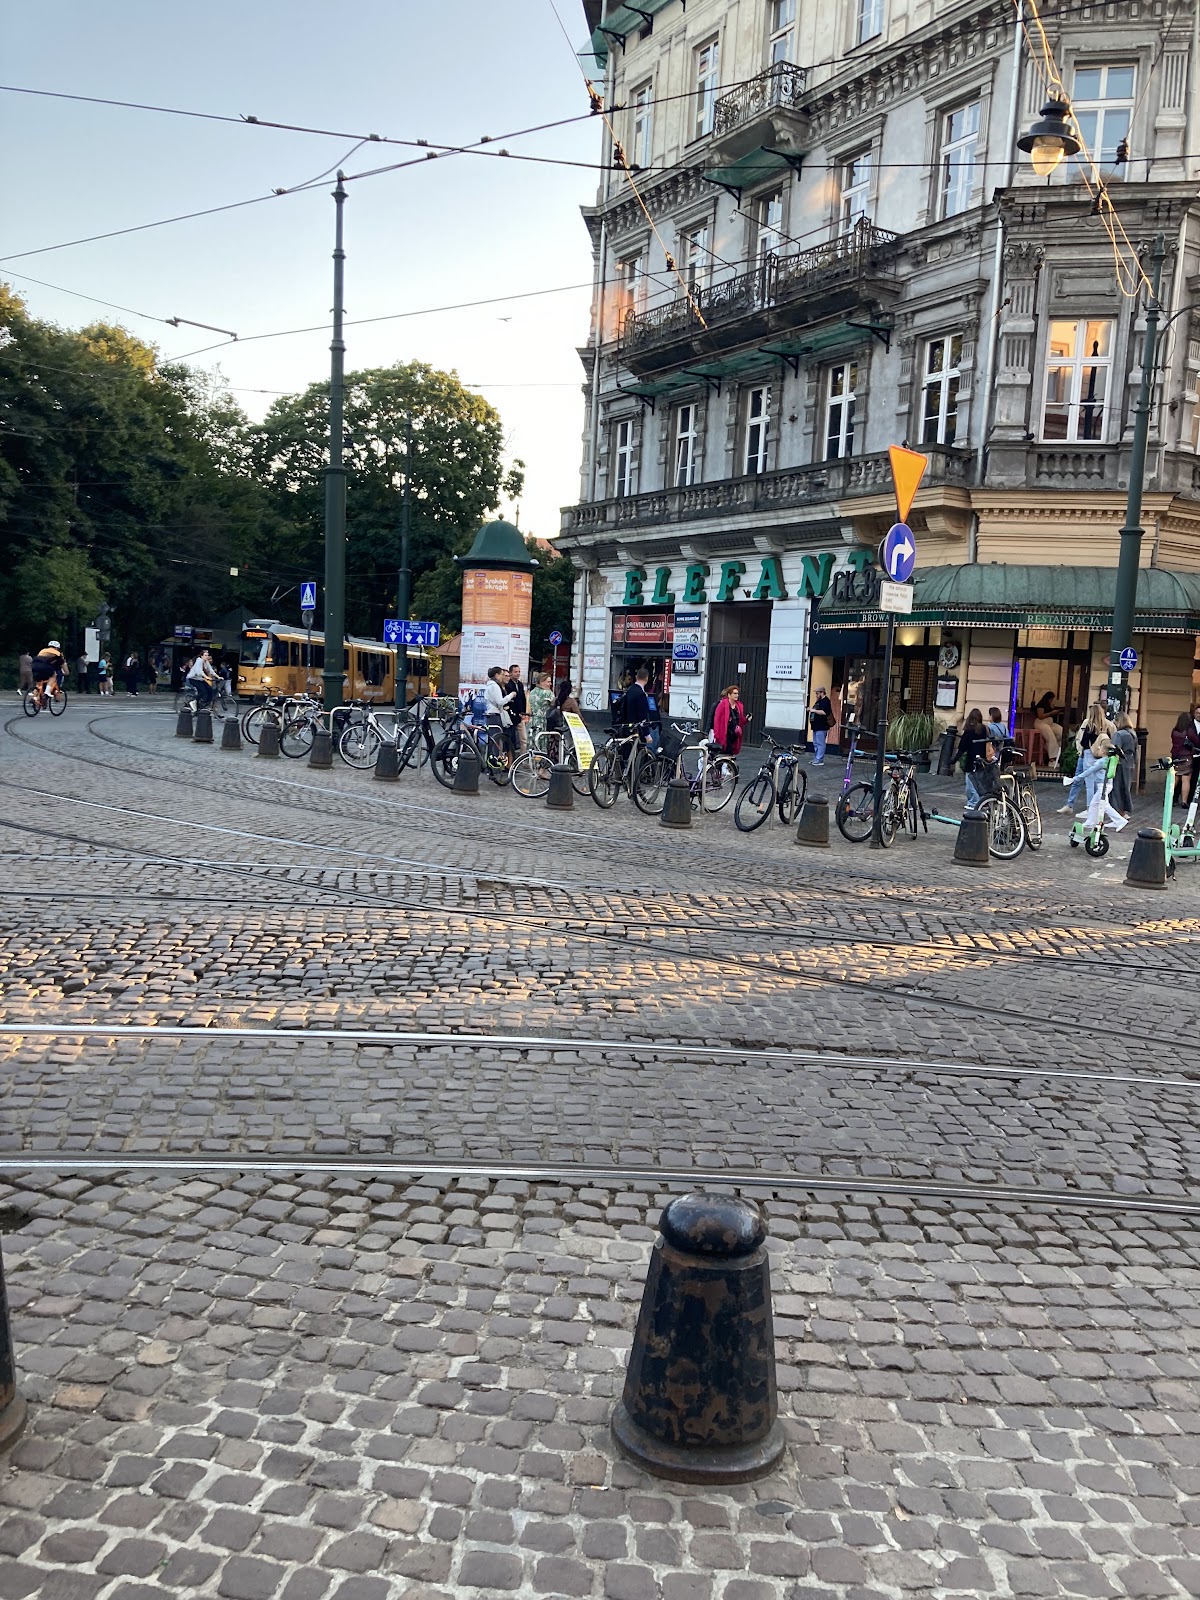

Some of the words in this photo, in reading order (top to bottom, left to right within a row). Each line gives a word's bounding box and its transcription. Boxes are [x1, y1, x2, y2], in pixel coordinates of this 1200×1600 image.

[622, 549, 874, 605] ELEFANT
[626, 621, 651, 629] ORIENTALNY
[1027, 614, 1101, 625] RESTAURACJA
[675, 644, 698, 654] BIELIZNA
[674, 660, 685, 671] NEW
